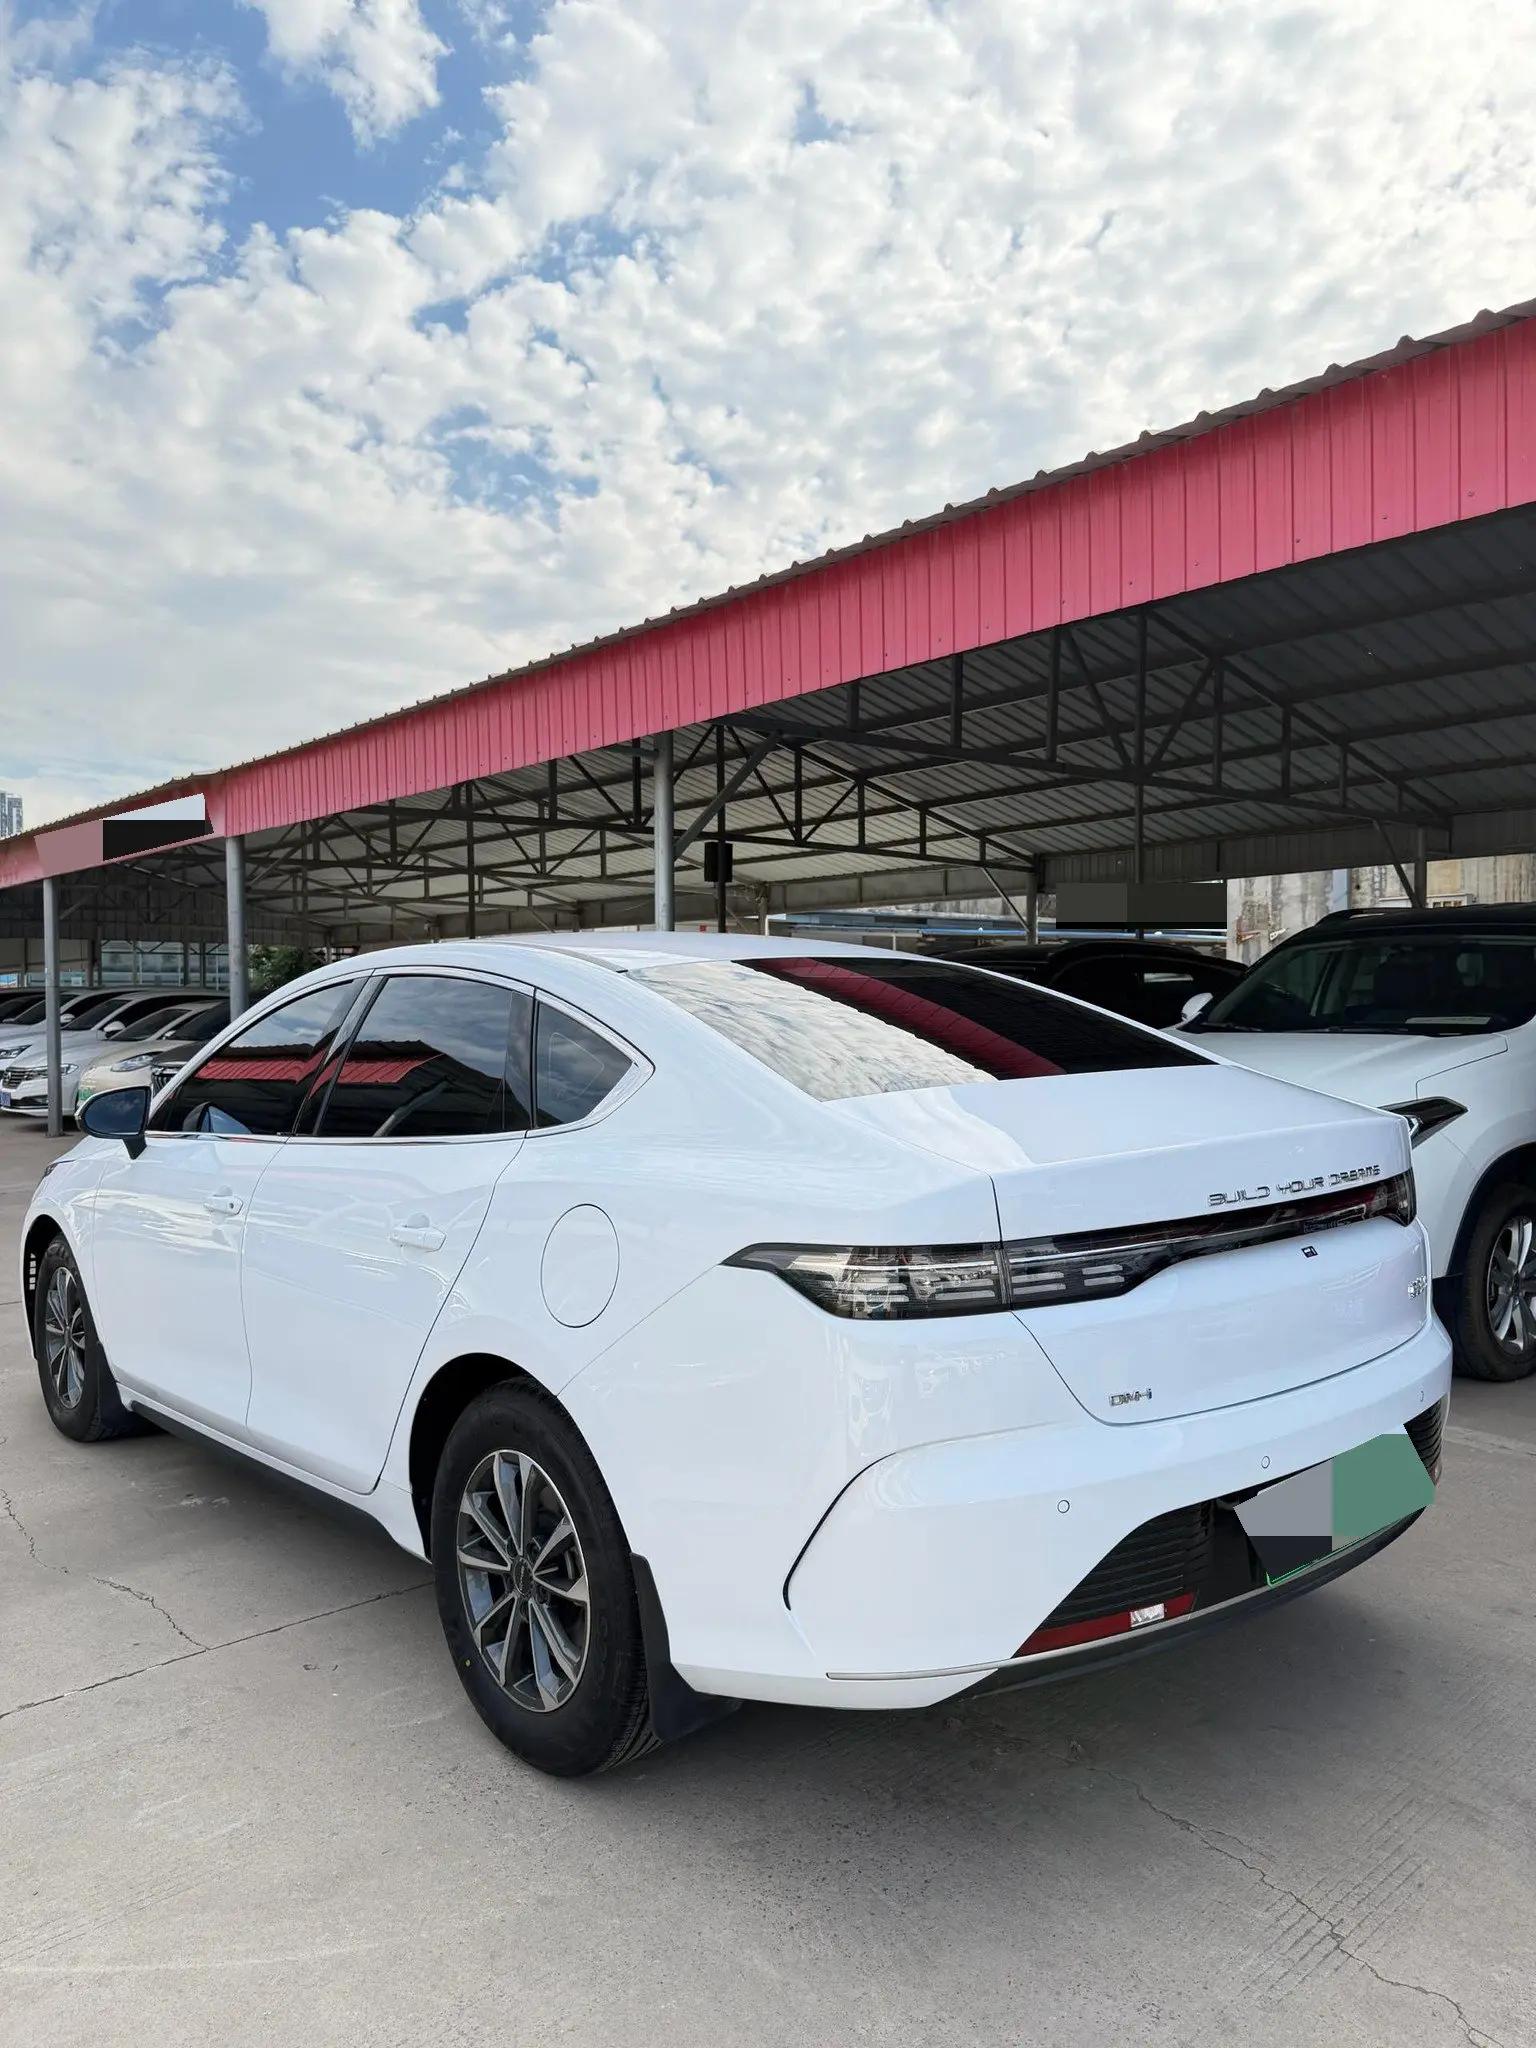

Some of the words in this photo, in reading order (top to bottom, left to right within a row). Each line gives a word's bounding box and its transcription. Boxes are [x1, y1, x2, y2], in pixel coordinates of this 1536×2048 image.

[1208, 1186, 1271, 1207] BUILD
[1277, 1176, 1325, 1194] YOUR
[1328, 1164, 1381, 1187] DREAMS
